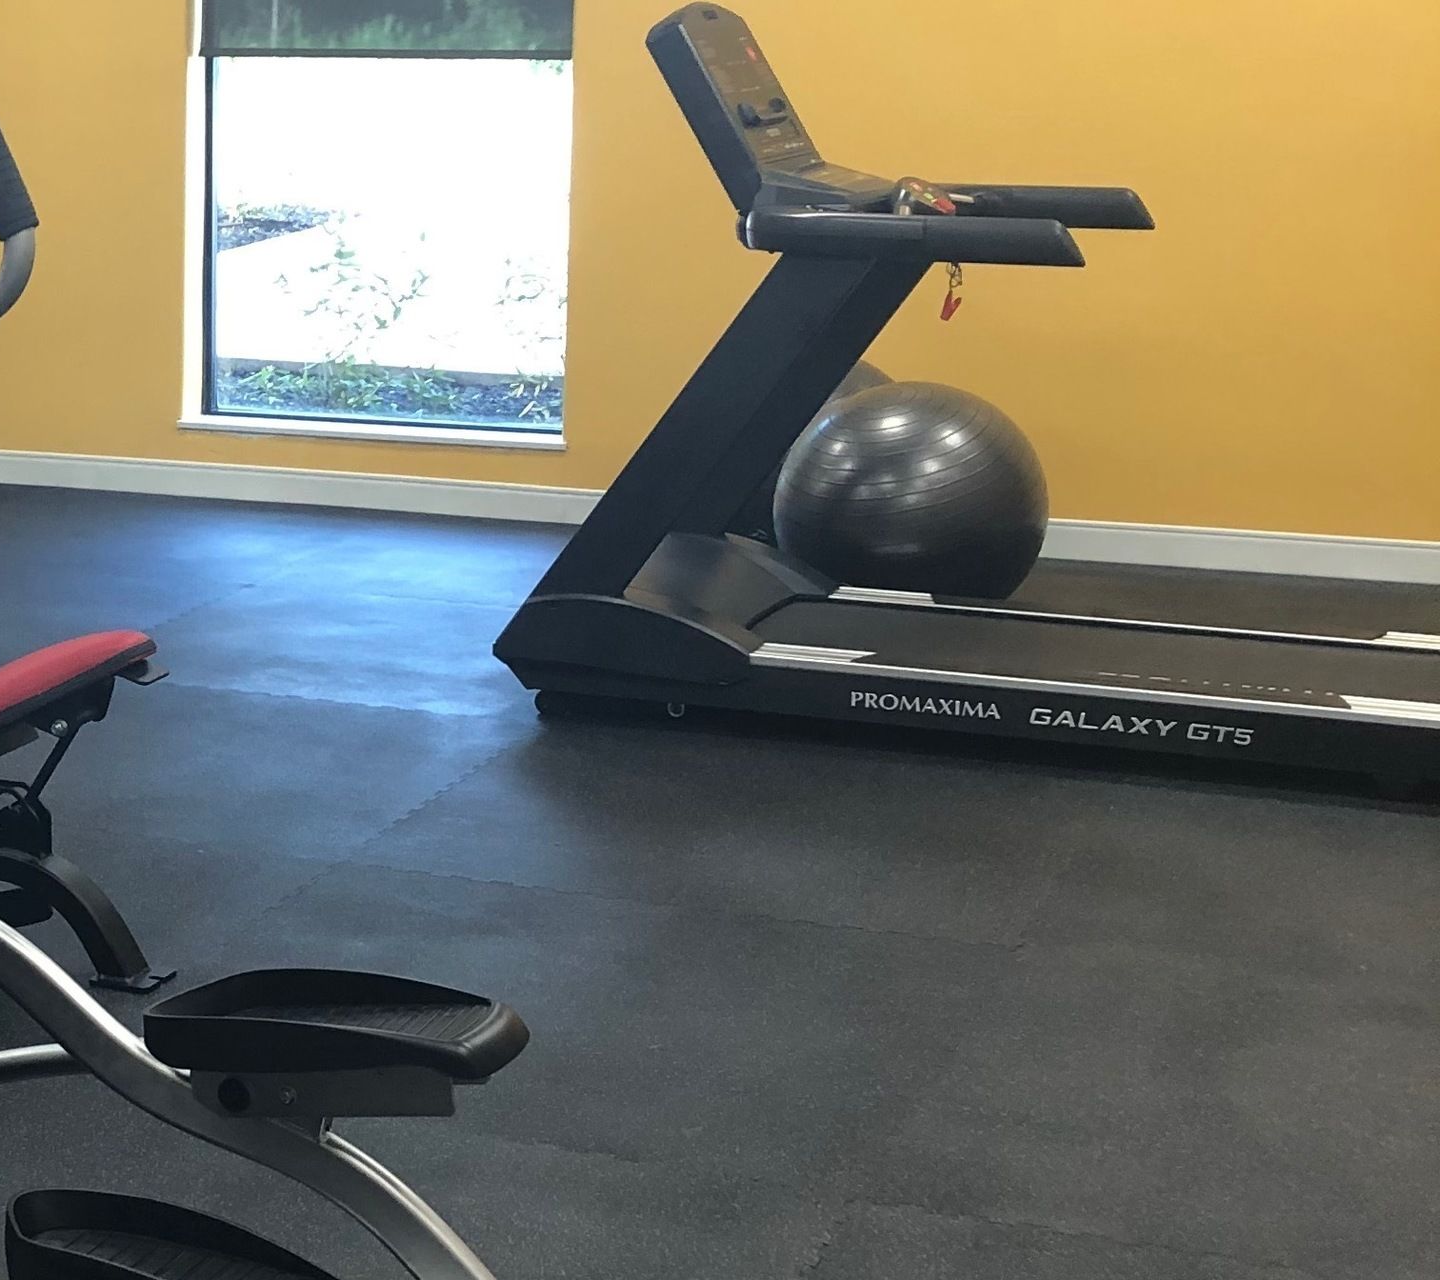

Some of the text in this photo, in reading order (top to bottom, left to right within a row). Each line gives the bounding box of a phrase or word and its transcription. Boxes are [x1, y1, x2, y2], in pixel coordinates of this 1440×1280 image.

[849, 690, 1255, 746] PROMAXIMA GALAXY GT5
